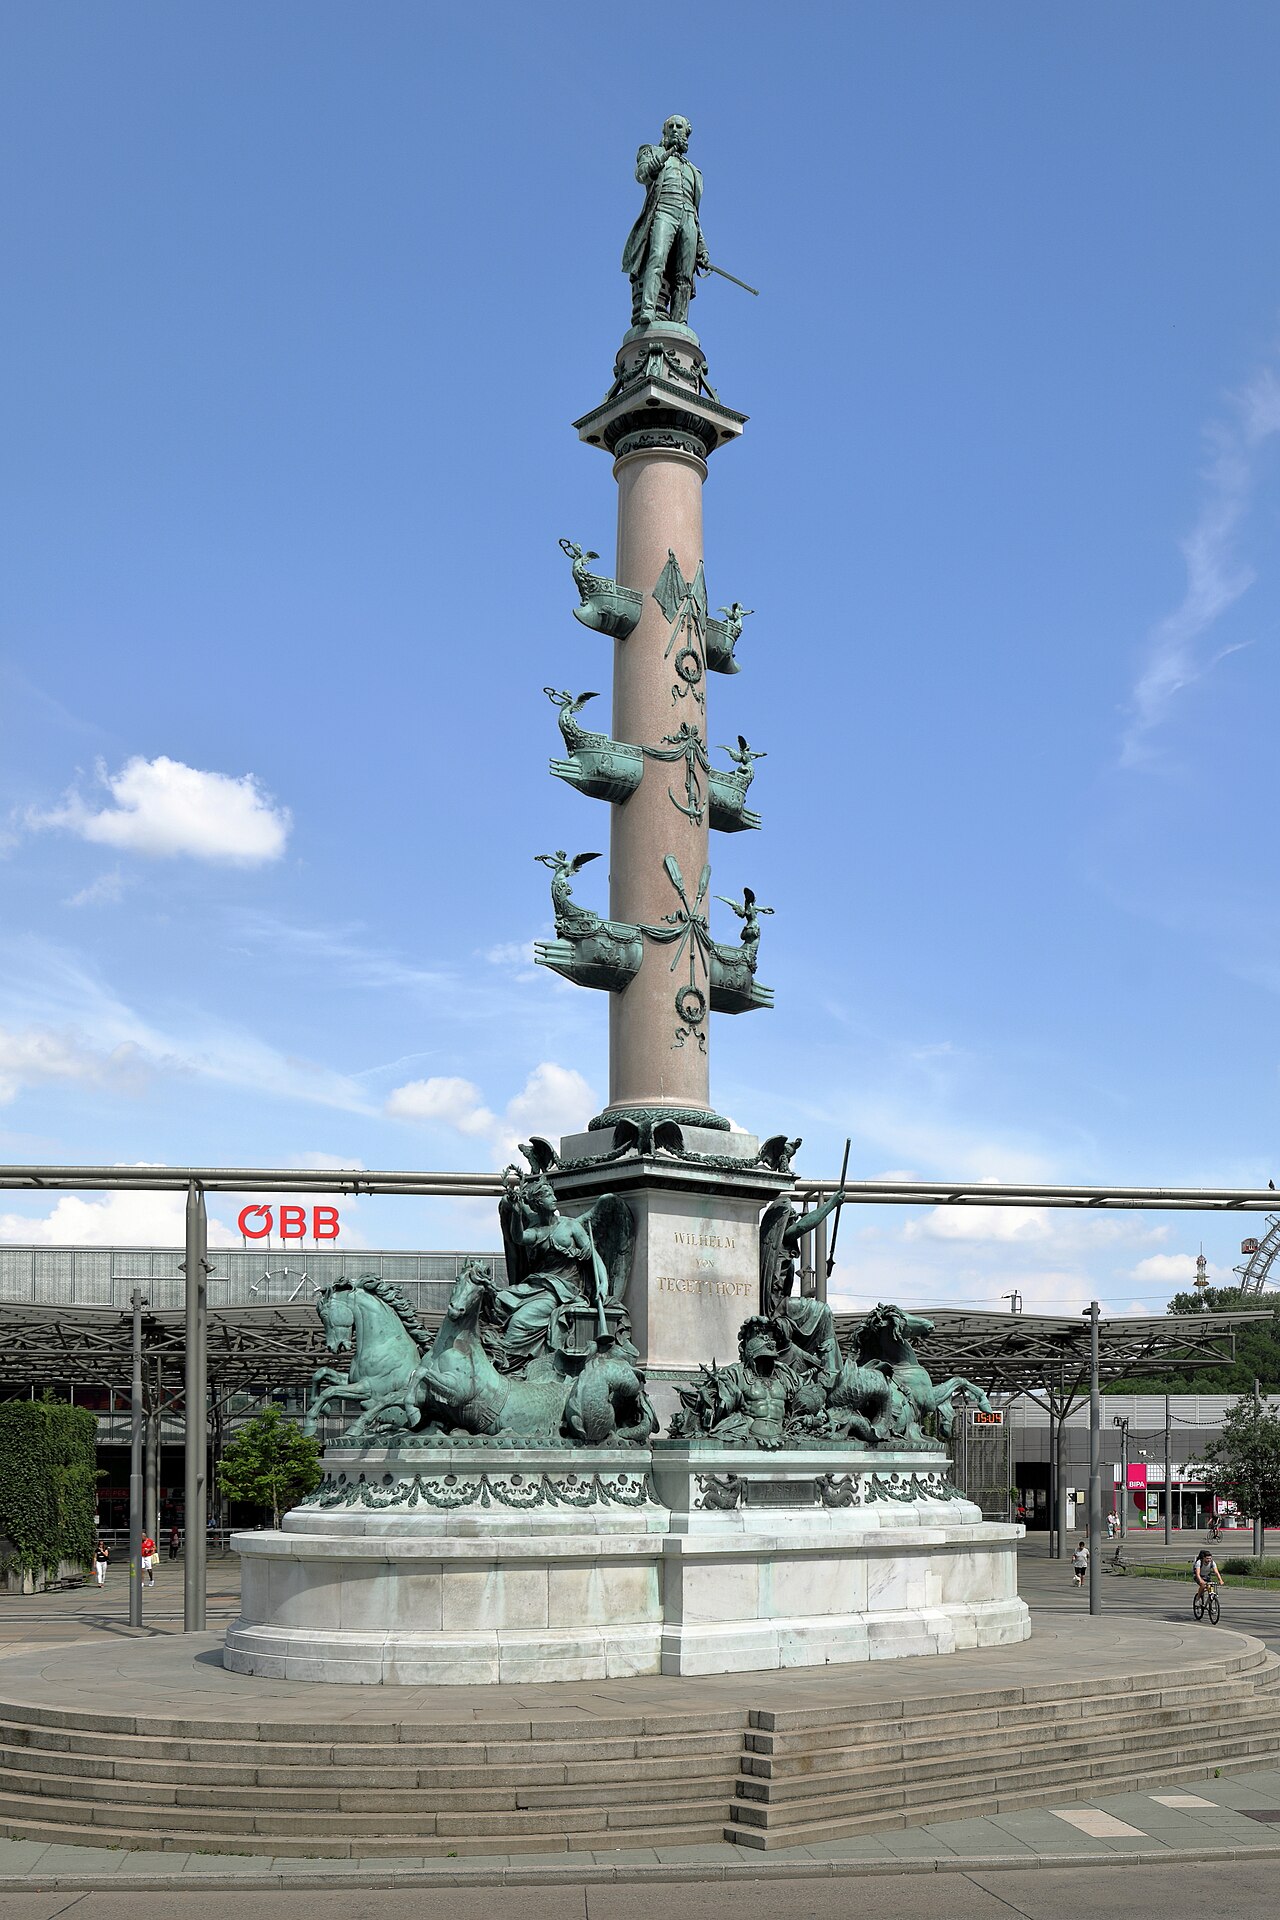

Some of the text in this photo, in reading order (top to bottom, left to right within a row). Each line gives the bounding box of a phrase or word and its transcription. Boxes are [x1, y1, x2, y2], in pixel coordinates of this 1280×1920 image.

[238, 1204, 340, 1239] ÖBB
[674, 1231, 736, 1249] WILHELM
[695, 1258, 715, 1268] VON
[977, 1412, 1001, 1423] 15:04
